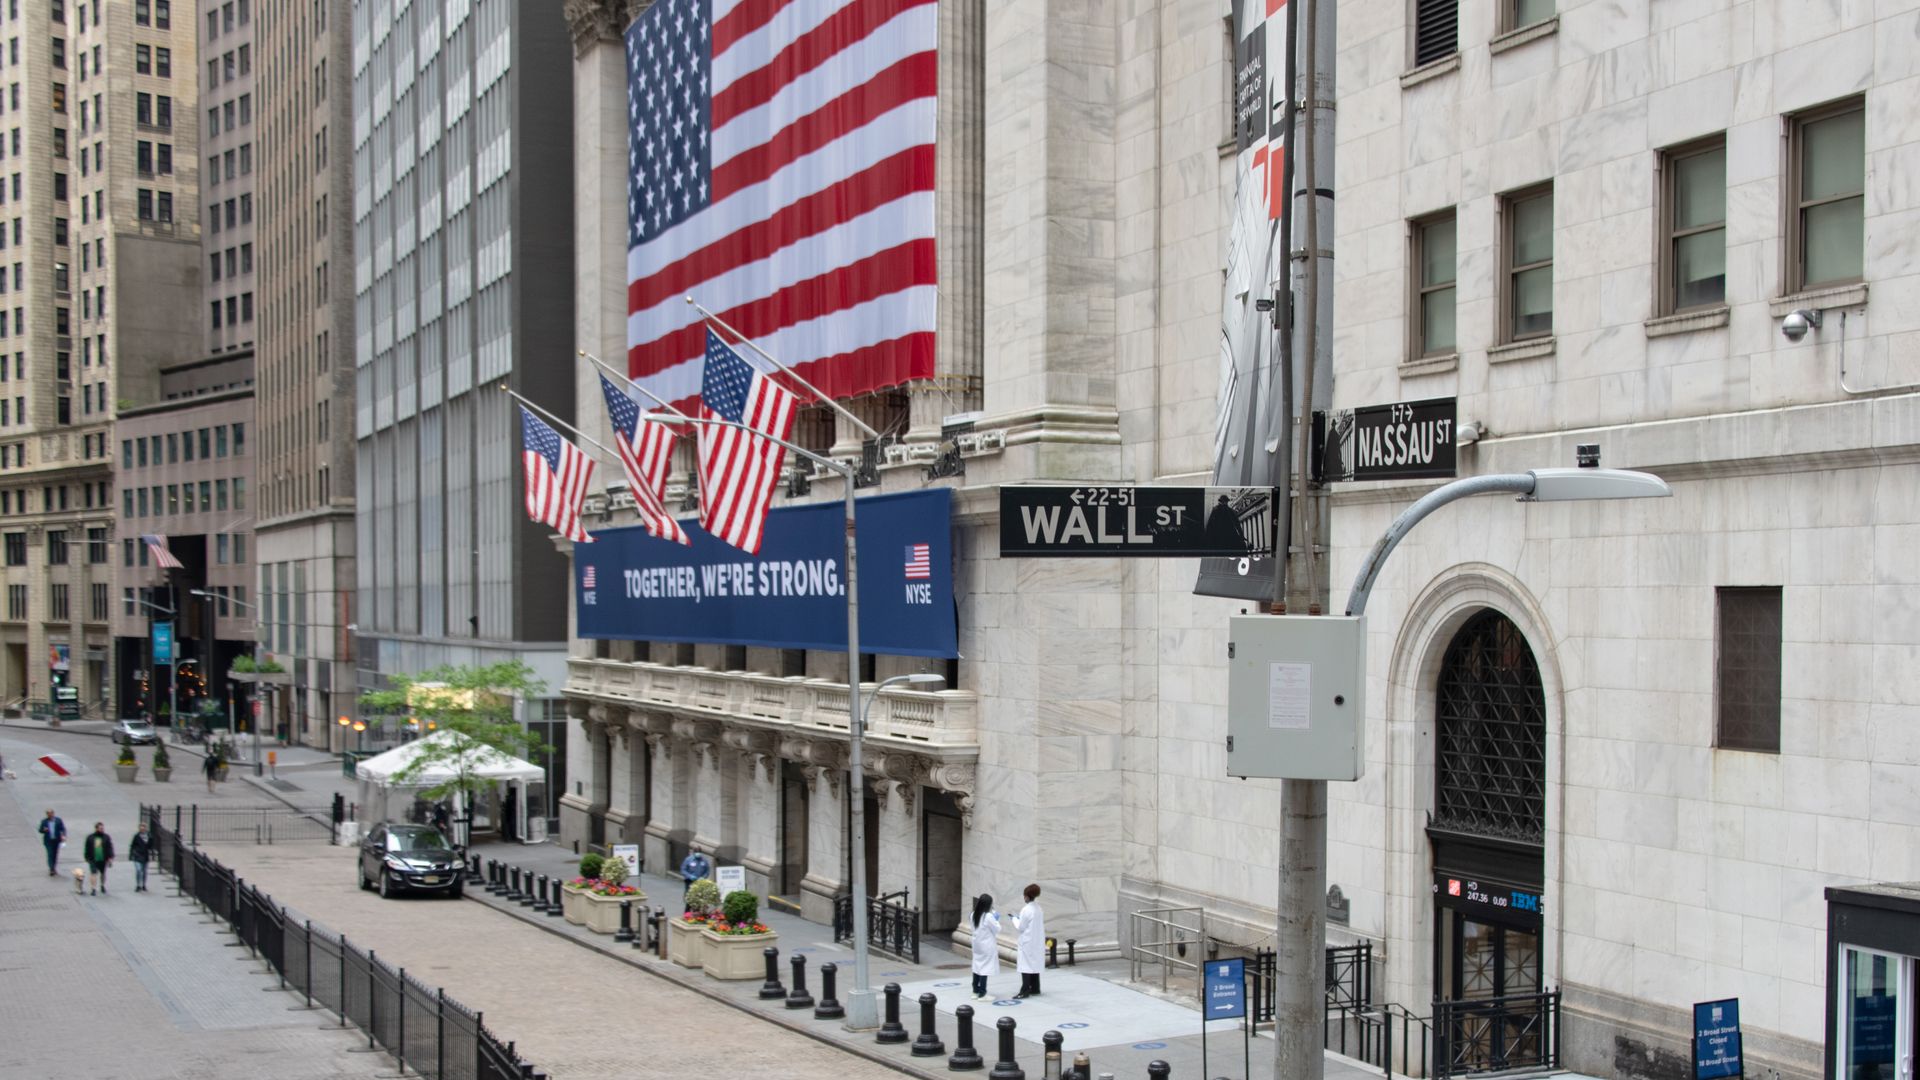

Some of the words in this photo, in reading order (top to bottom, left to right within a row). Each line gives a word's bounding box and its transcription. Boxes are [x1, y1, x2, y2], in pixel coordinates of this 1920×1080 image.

[1391, 404, 1405, 424] 1-7
[1359, 421, 1434, 467] NASSAU
[1436, 418, 1452, 445] ST
[1087, 488, 1136, 506] 22-51
[1020, 505, 1154, 544] WALL
[1156, 505, 1187, 526] ST
[624, 566, 701, 603] TOGETHER,
[701, 562, 755, 597] WE'RE
[758, 558, 845, 597] STRONG.
[905, 583, 932, 605] NYSE
[1467, 881, 1478, 891] HD
[1510, 891, 1537, 912] IBM
[1703, 1028, 1720, 1037] Broad
[1720, 1025, 1737, 1034] Street
